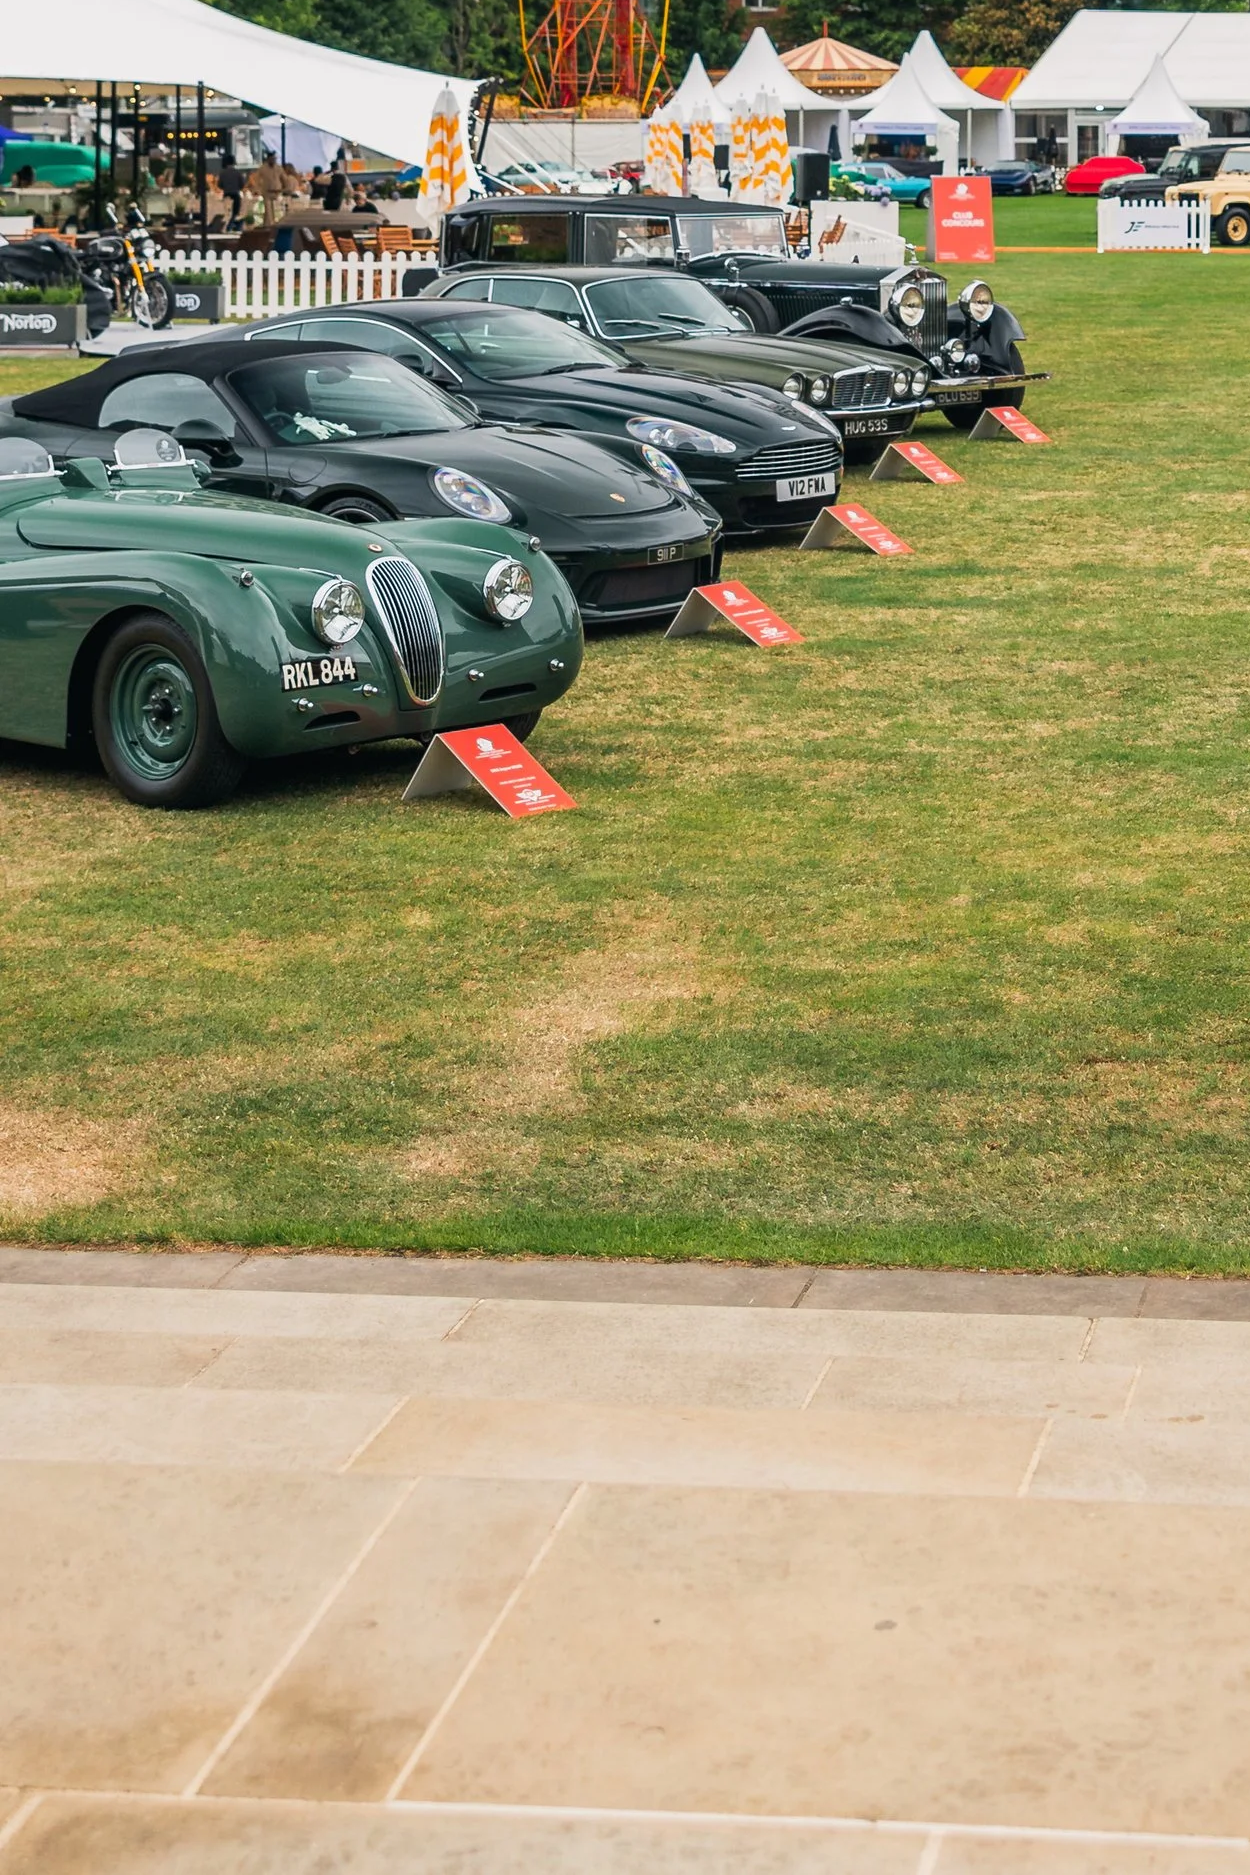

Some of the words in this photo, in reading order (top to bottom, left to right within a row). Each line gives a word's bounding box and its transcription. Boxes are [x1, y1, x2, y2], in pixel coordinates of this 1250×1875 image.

[0, 313, 57, 334] Norton
[845, 420, 866, 435] HUG
[867, 418, 888, 432] 53S
[788, 479, 806, 496] V12
[807, 476, 826, 494] FWA
[282, 661, 320, 690] RKL
[320, 656, 356, 684] 844
